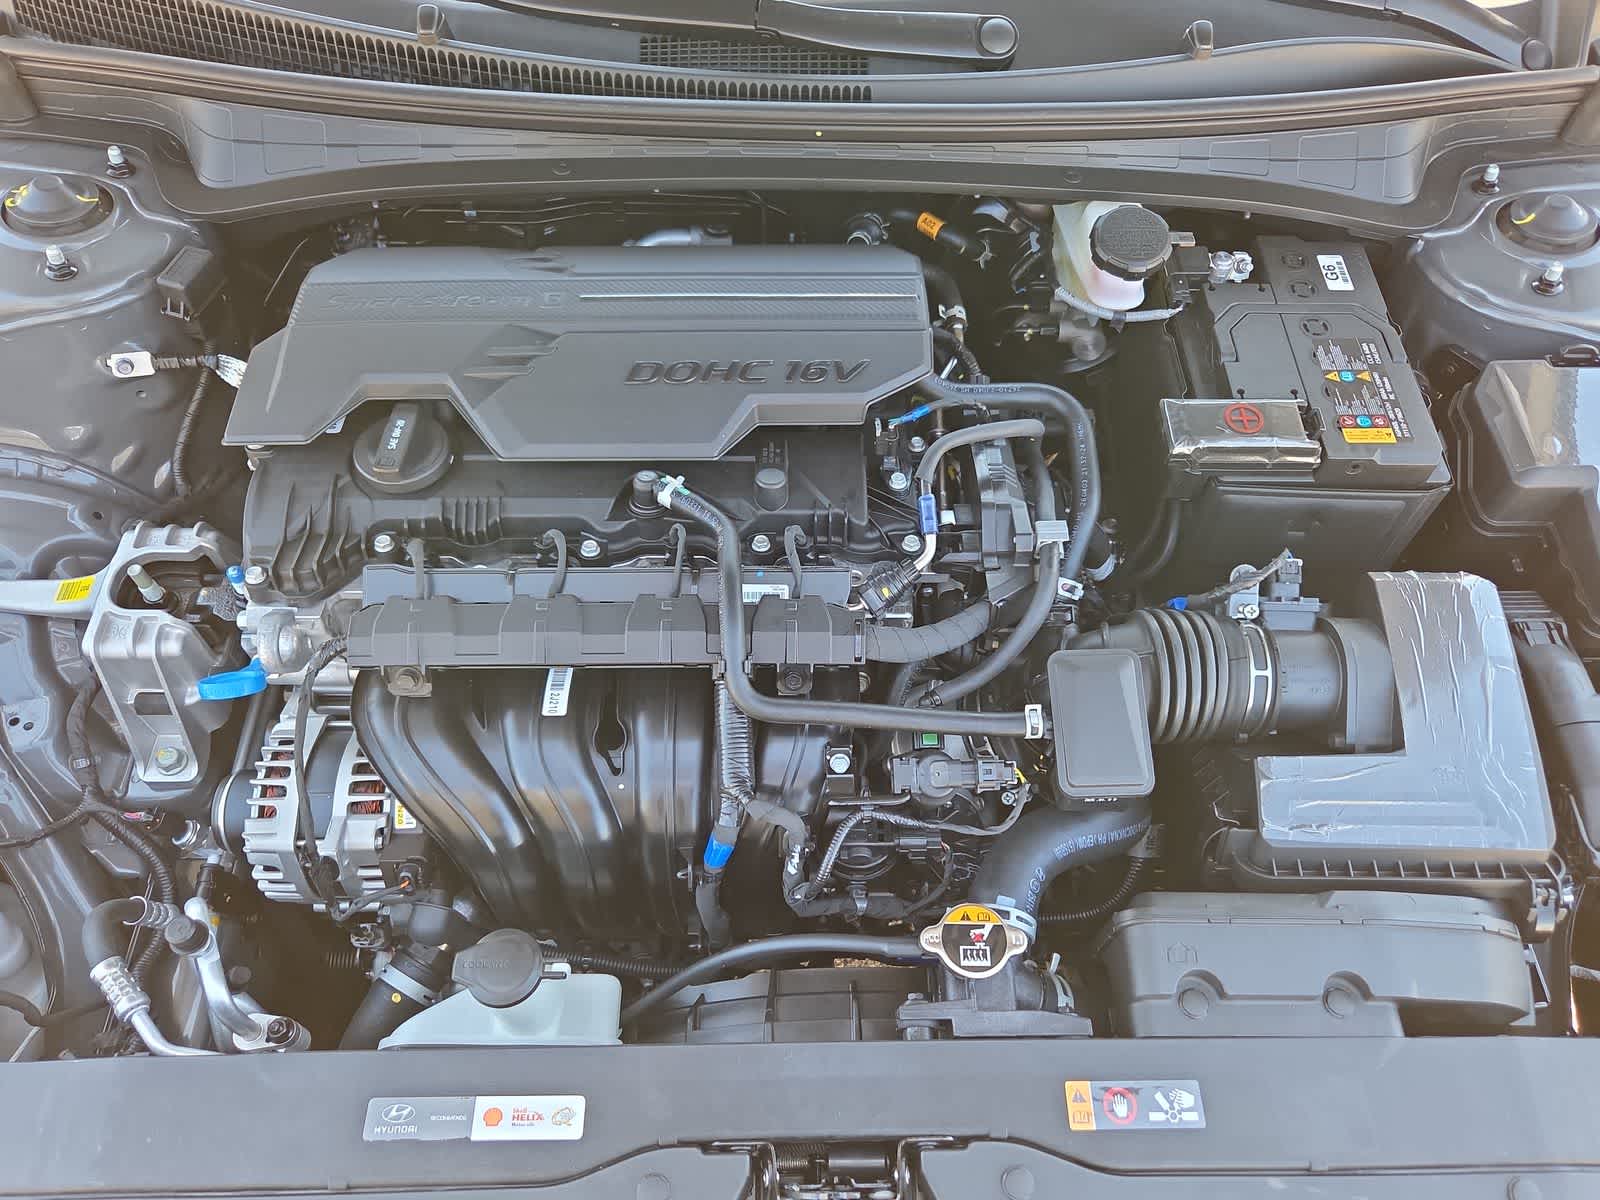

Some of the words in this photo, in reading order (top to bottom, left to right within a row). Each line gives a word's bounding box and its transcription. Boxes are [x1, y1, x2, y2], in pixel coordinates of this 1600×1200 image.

[1323, 264, 1339, 280] G6
[624, 360, 775, 386] DOHC
[784, 359, 872, 385] 16V
[547, 692, 560, 714] 2J210
[511, 1113, 545, 1121] HELIX
[374, 1125, 417, 1135] HYUNDAI
